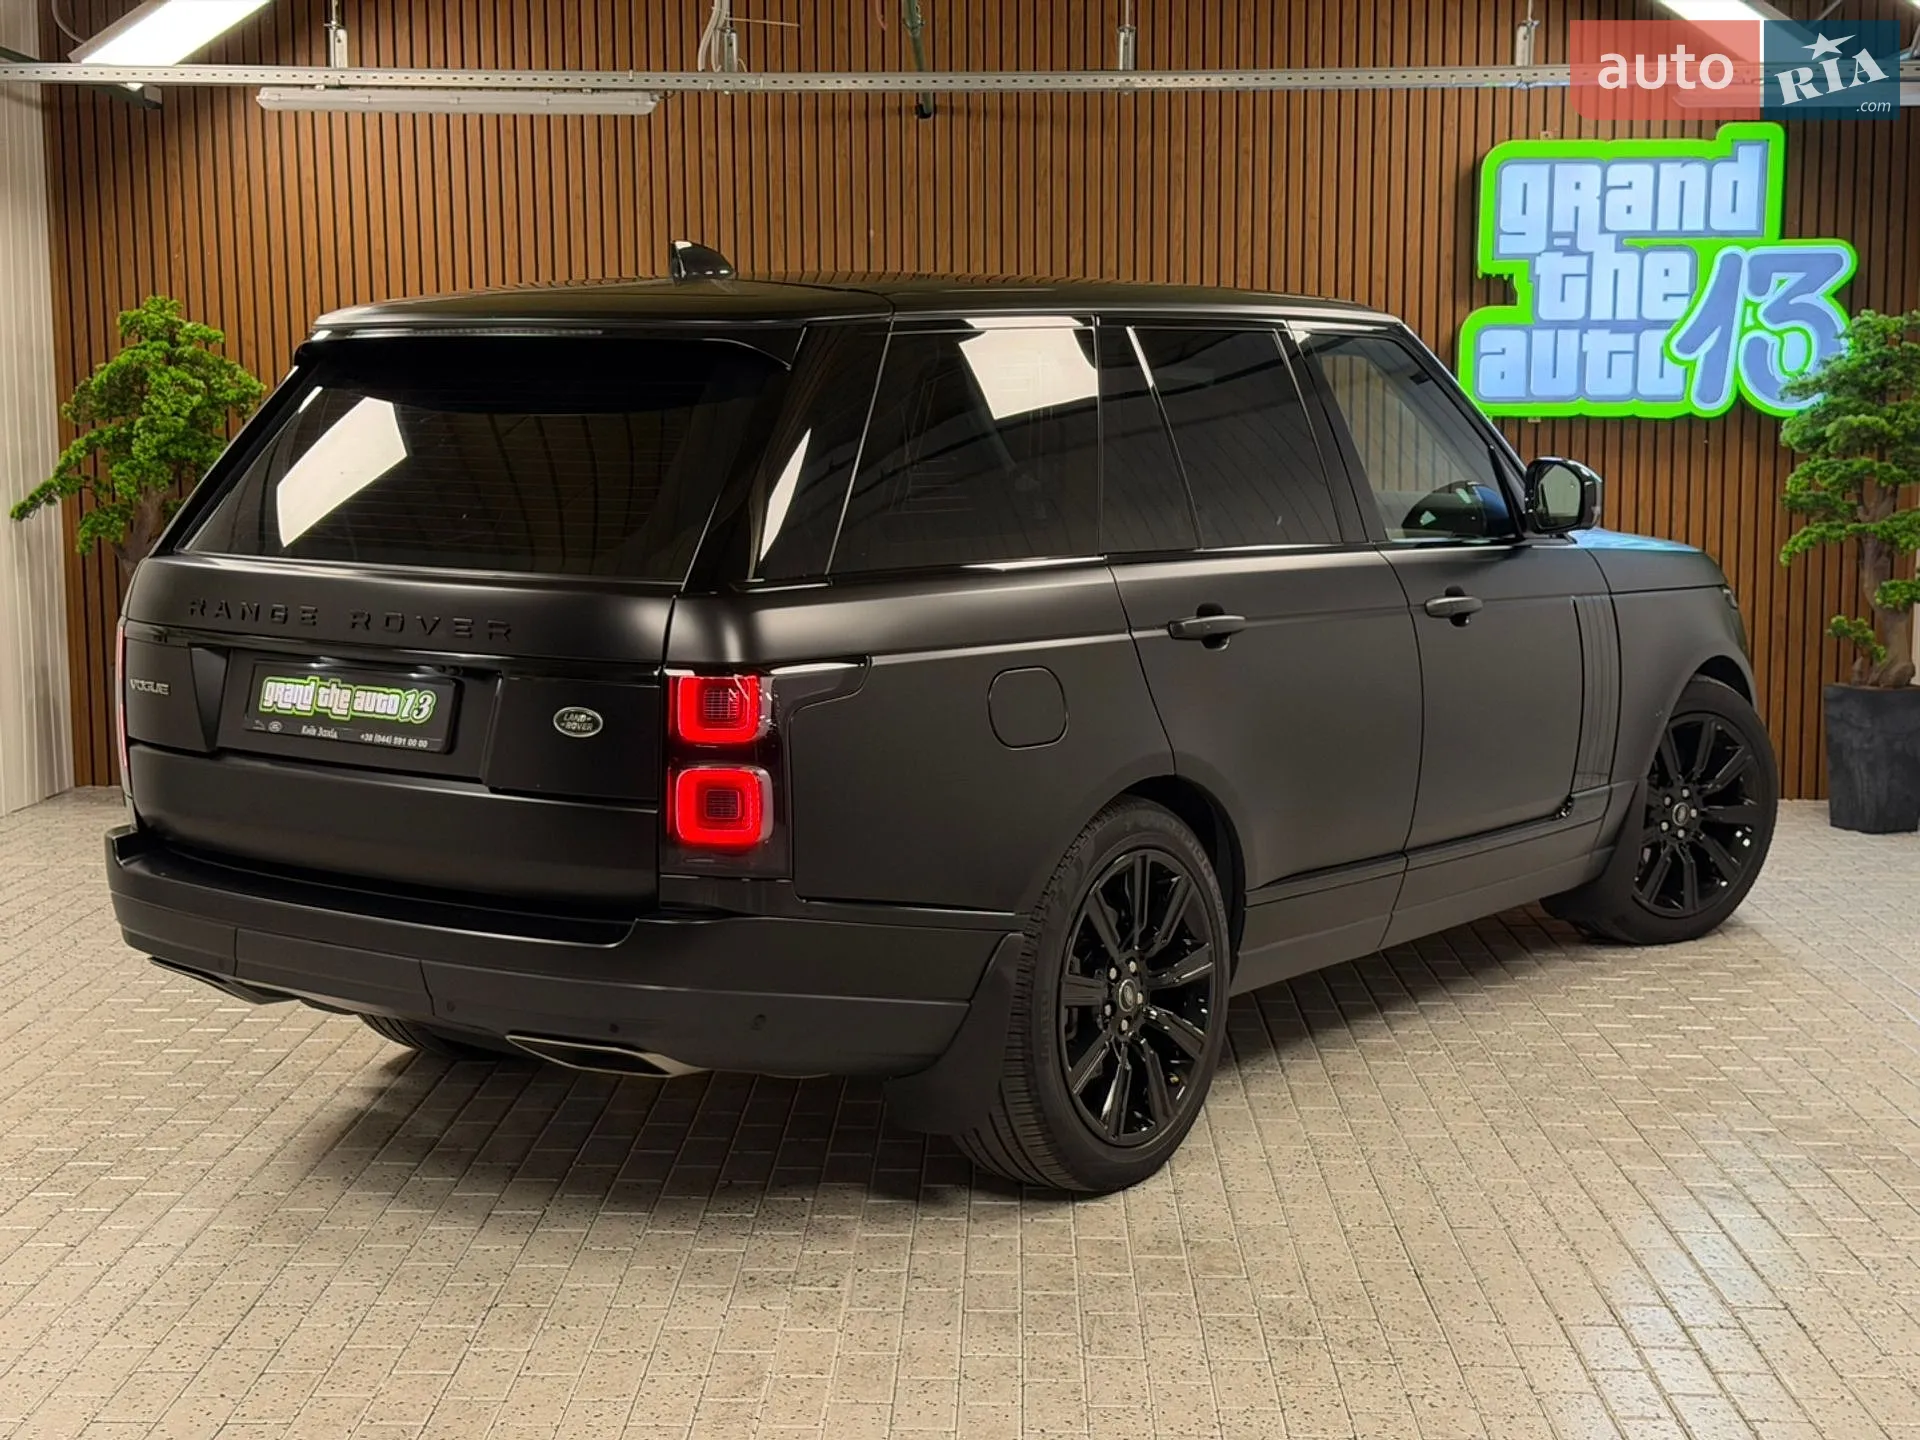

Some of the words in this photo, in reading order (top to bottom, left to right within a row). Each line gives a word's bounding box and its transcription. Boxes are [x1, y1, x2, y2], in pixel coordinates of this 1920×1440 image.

[1534, 233, 1692, 321] the
[1668, 246, 1851, 412] 13
[1477, 327, 1688, 399] auto
[189, 600, 318, 626] RANGE
[350, 608, 512, 641] ROVER
[129, 679, 169, 695] VOGUE
[318, 682, 352, 715] the
[353, 690, 401, 715] auto
[400, 692, 433, 720] 13
[563, 713, 587, 722] LAND
[565, 721, 593, 731] ROVER
